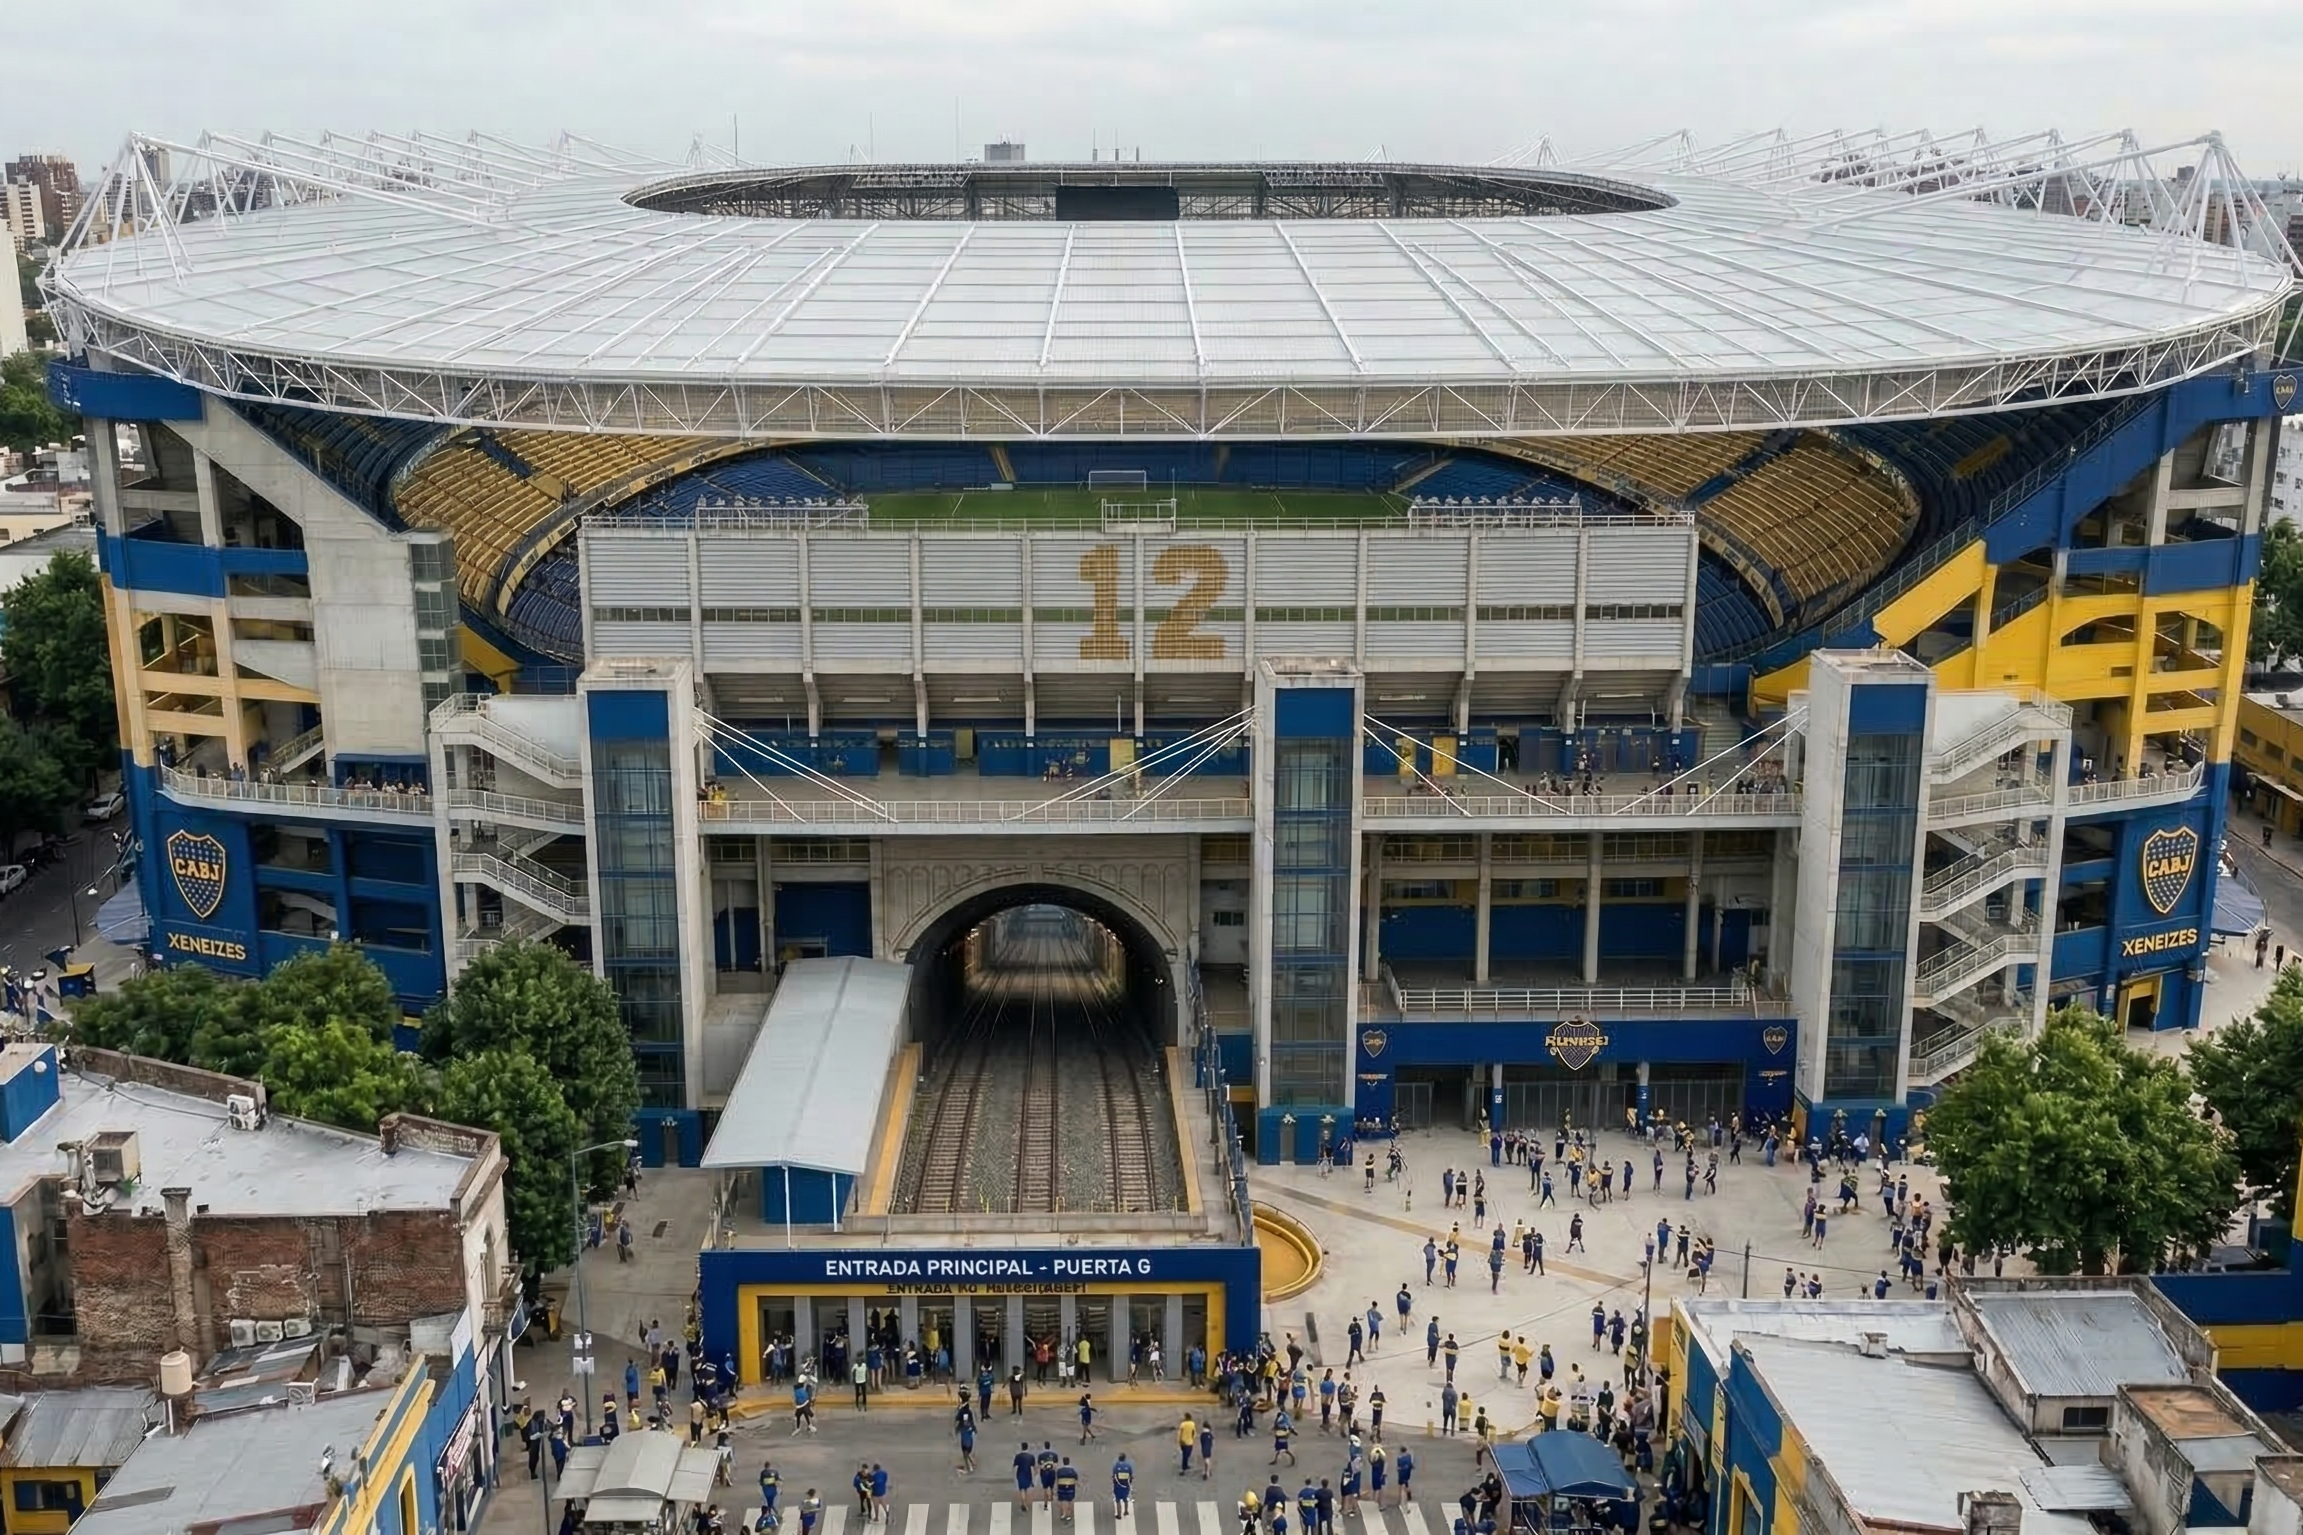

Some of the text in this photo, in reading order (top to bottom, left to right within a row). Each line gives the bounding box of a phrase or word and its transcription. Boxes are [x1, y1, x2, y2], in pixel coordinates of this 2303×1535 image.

[1080, 543, 1229, 660] 12
[175, 858, 219, 880] CABJ
[2148, 855, 2191, 878] CABJ
[168, 932, 246, 960] XENEIZES
[2122, 928, 2197, 956] XENEIZES
[825, 1259, 922, 1276] ENTRADA
[927, 1259, 1034, 1276] PRINCIPAL
[1053, 1258, 1132, 1275] PUERTA
[1137, 1257, 1152, 1275] G
